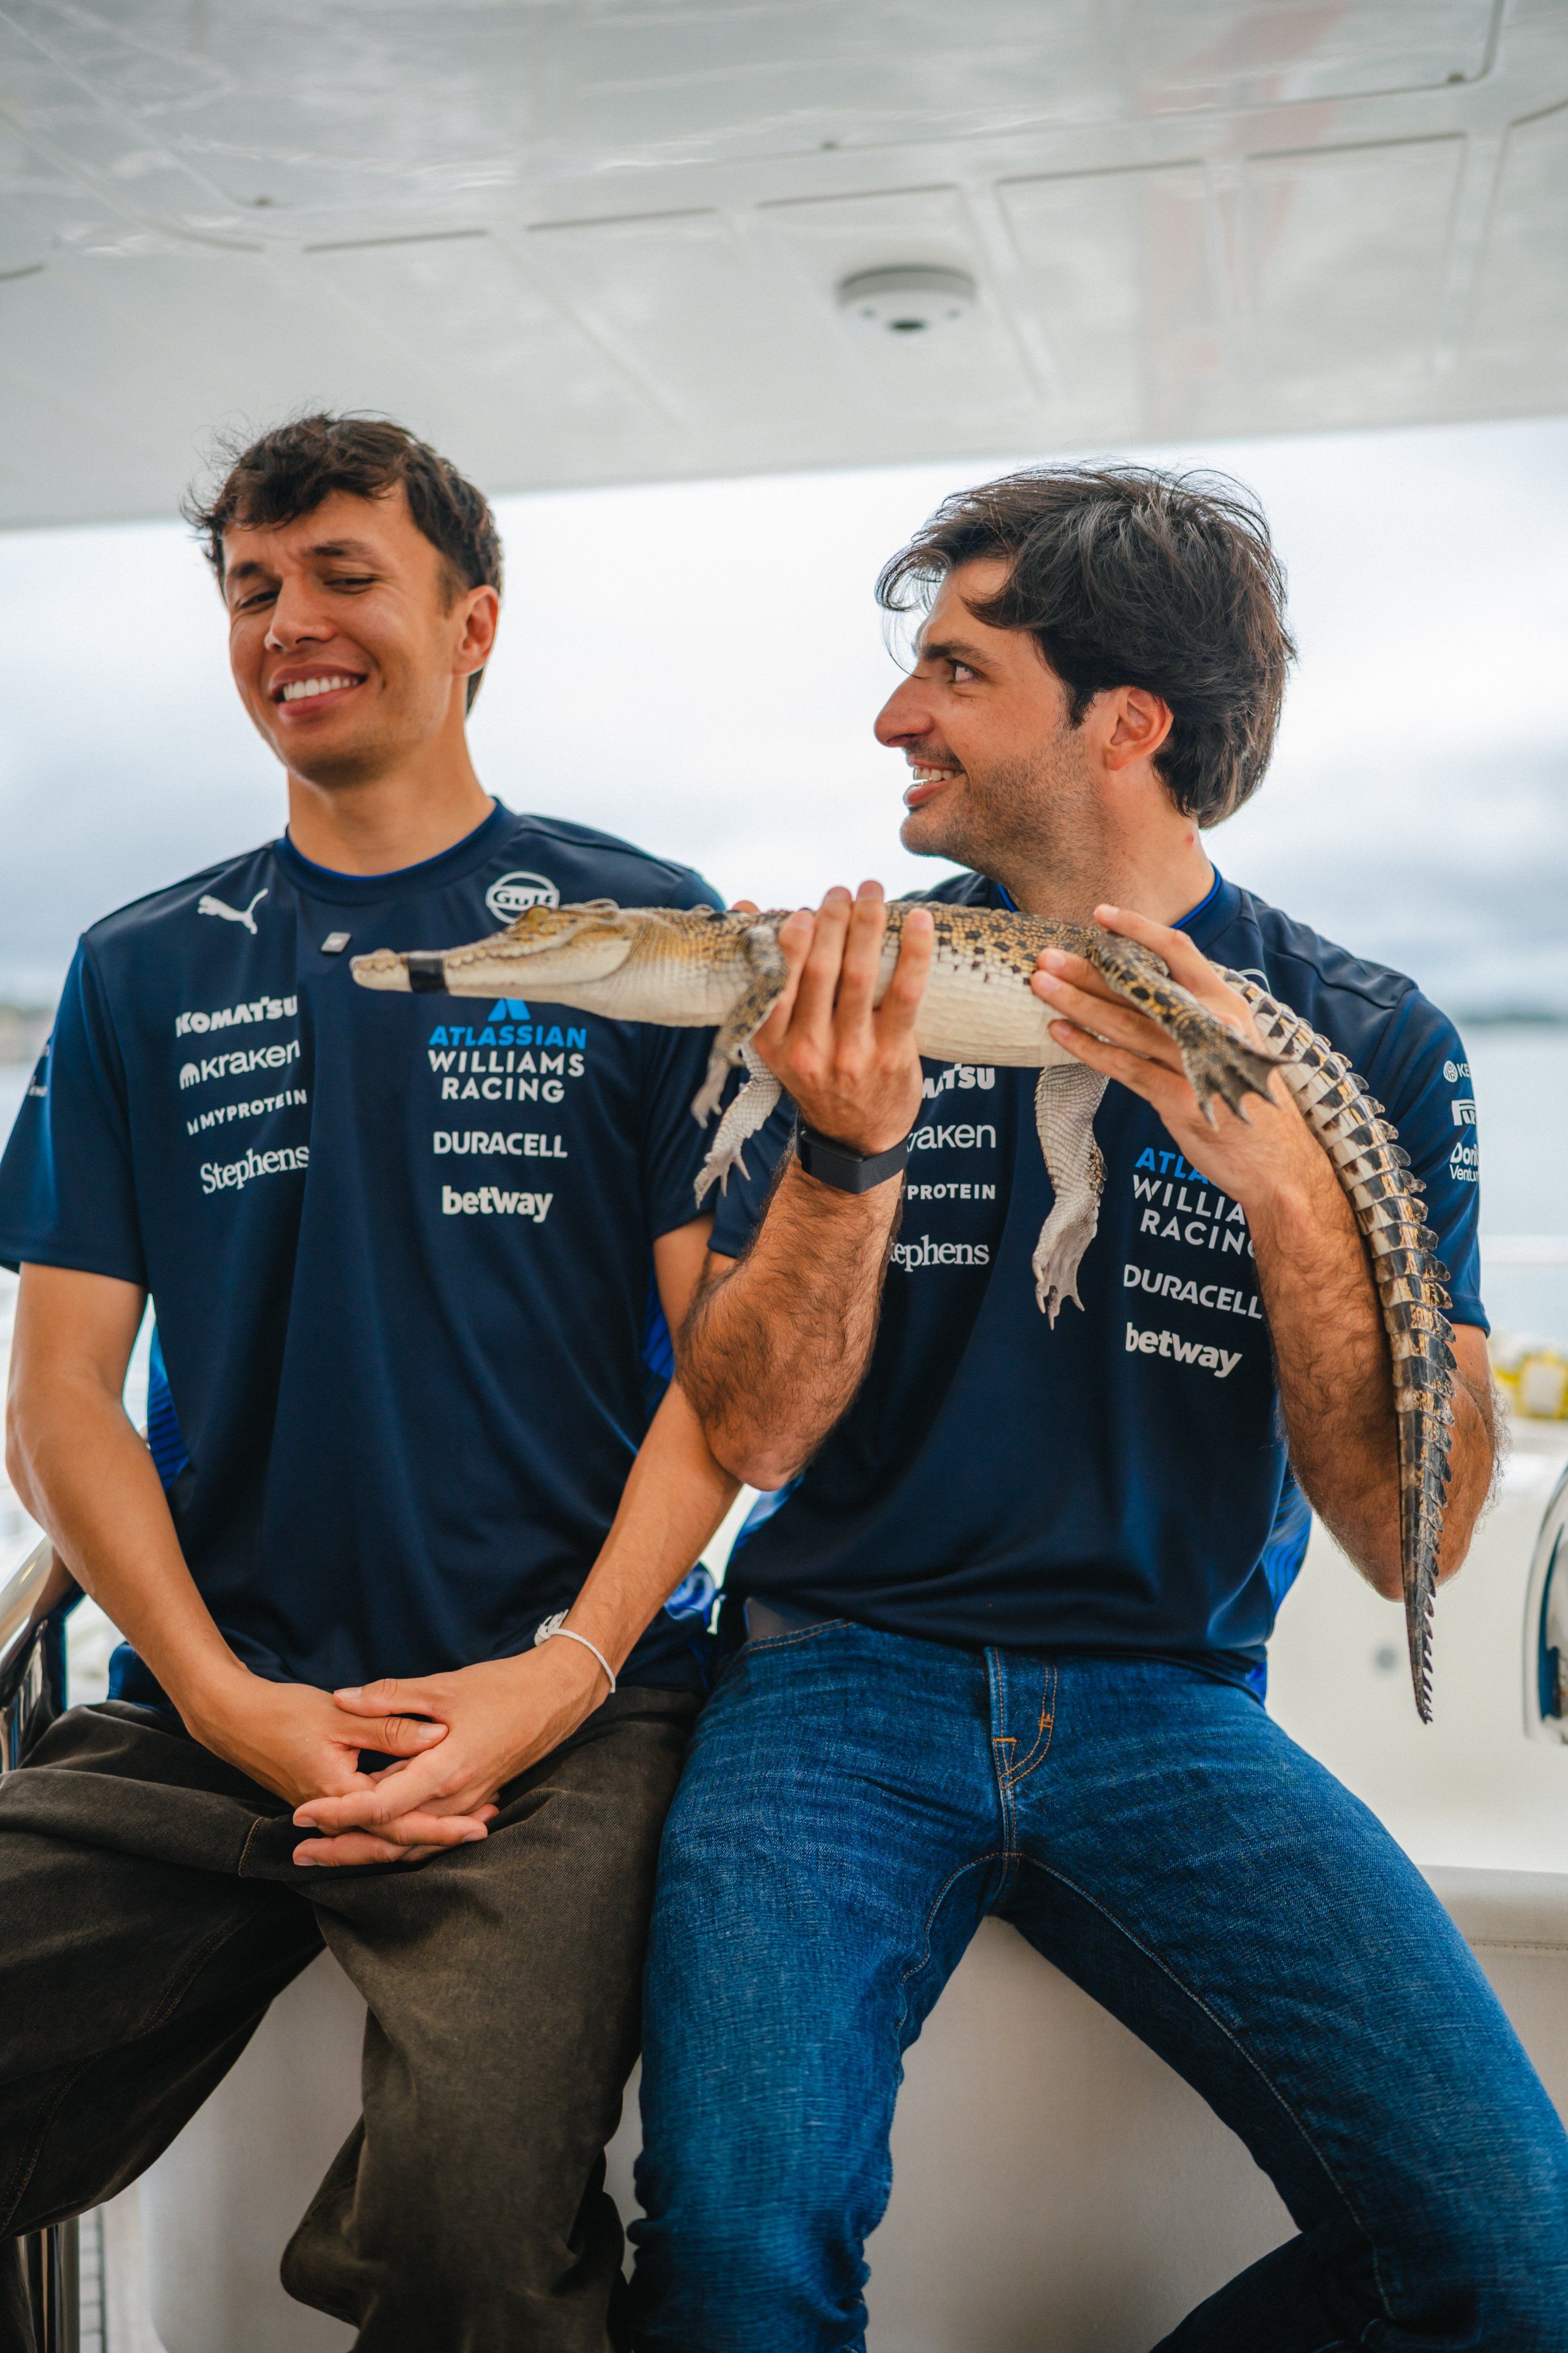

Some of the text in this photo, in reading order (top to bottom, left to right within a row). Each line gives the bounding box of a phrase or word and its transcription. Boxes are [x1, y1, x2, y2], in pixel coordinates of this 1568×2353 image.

[493, 890, 553, 907] Gulf
[176, 995, 298, 1038] KOMATSU
[428, 1025, 587, 1050] ATLASSIAN
[201, 1039, 301, 1082] kraken
[428, 1049, 585, 1077] WILLIAMS
[441, 1076, 565, 1103] RACING
[200, 1088, 308, 1130] MYPROTEIN
[433, 1130, 568, 1158] DURACELL
[1450, 1142, 1479, 1167] Dori
[200, 1145, 310, 1194] Stephens
[1135, 1147, 1219, 1188] ATLA
[442, 1185, 554, 1223] betway
[899, 1183, 996, 1200] PROTEIN
[1123, 1264, 1262, 1320] DURACELL
[1126, 1322, 1243, 1378] betway
